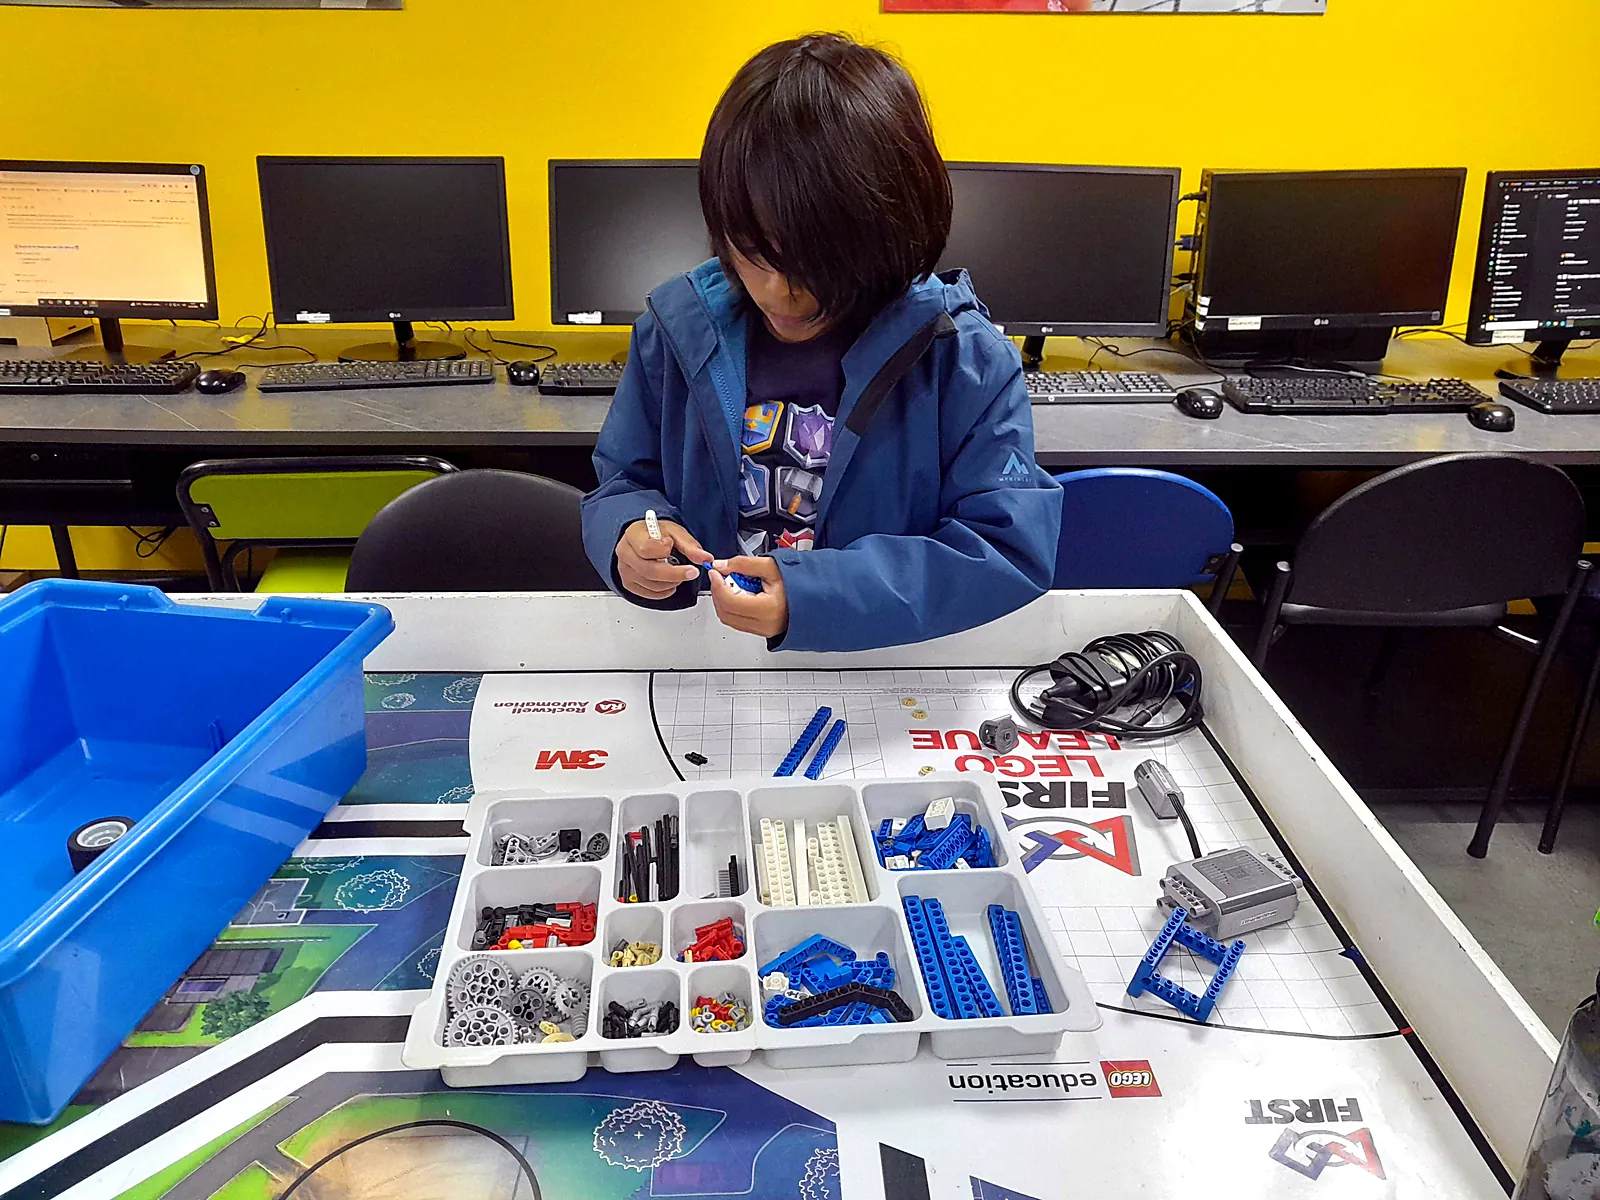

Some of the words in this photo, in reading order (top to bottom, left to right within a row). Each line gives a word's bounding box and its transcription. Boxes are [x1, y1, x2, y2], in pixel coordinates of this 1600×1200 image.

[511, 707, 587, 715] Rockwell
[908, 729, 1122, 751] LEAUE
[534, 750, 609, 770] 3M
[954, 755, 1105, 778] LEGO
[997, 781, 1127, 809] FIRS
[948, 1072, 1097, 1094] education
[1109, 1071, 1151, 1087] LEGO
[1244, 1097, 1364, 1125] FIRST
